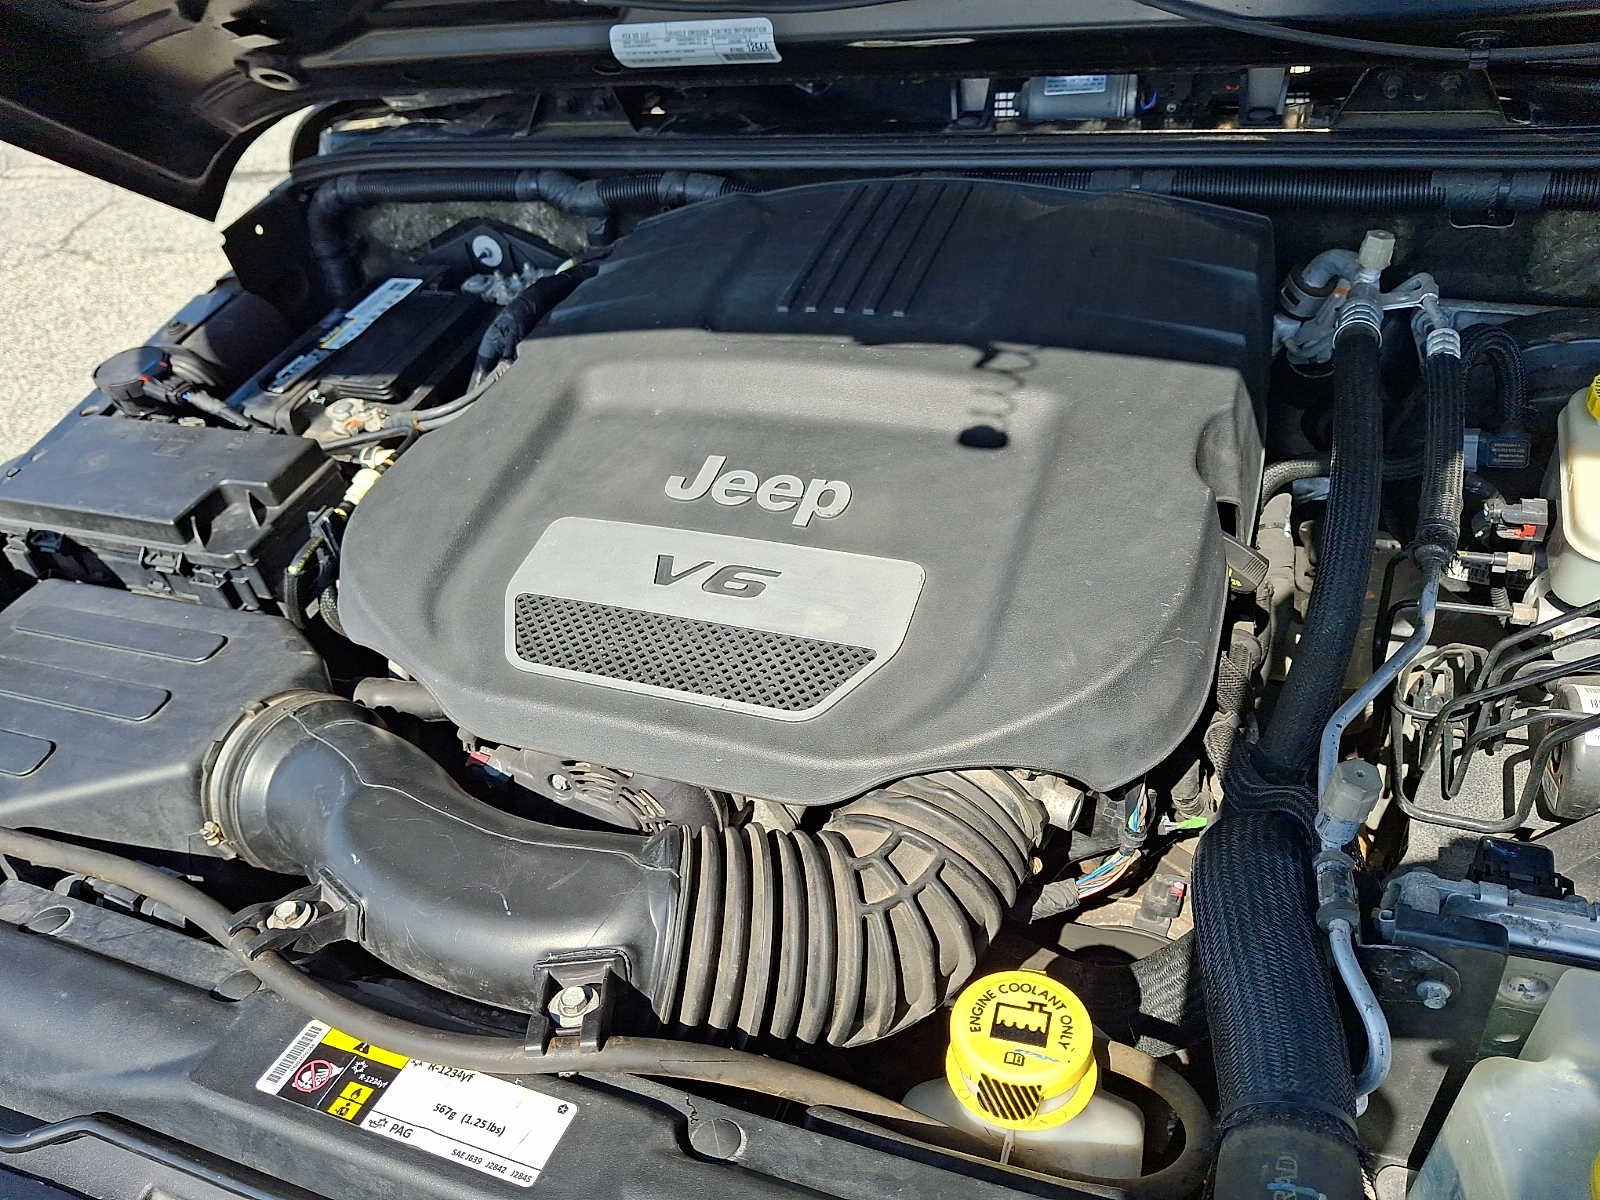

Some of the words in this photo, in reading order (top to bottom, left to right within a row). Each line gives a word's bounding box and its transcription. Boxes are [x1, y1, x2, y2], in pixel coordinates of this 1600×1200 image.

[664, 455, 853, 528] Jeep
[654, 553, 783, 599] V6
[969, 989, 997, 1033] ENGINE
[998, 982, 1068, 1011] COOLANT
[1058, 1015, 1075, 1050] ONLY
[359, 1073, 388, 1088] R-1234yf
[427, 1062, 475, 1083] R-1234yf
[388, 1123, 414, 1139] PAG
[432, 1102, 457, 1121] 567g
[460, 1112, 486, 1129] (1.25
[484, 1118, 506, 1137] lbs)
[450, 1148, 465, 1159] SAE
[465, 1152, 483, 1165] J639
[485, 1161, 507, 1174] J2842
[509, 1169, 532, 1183] J2845
